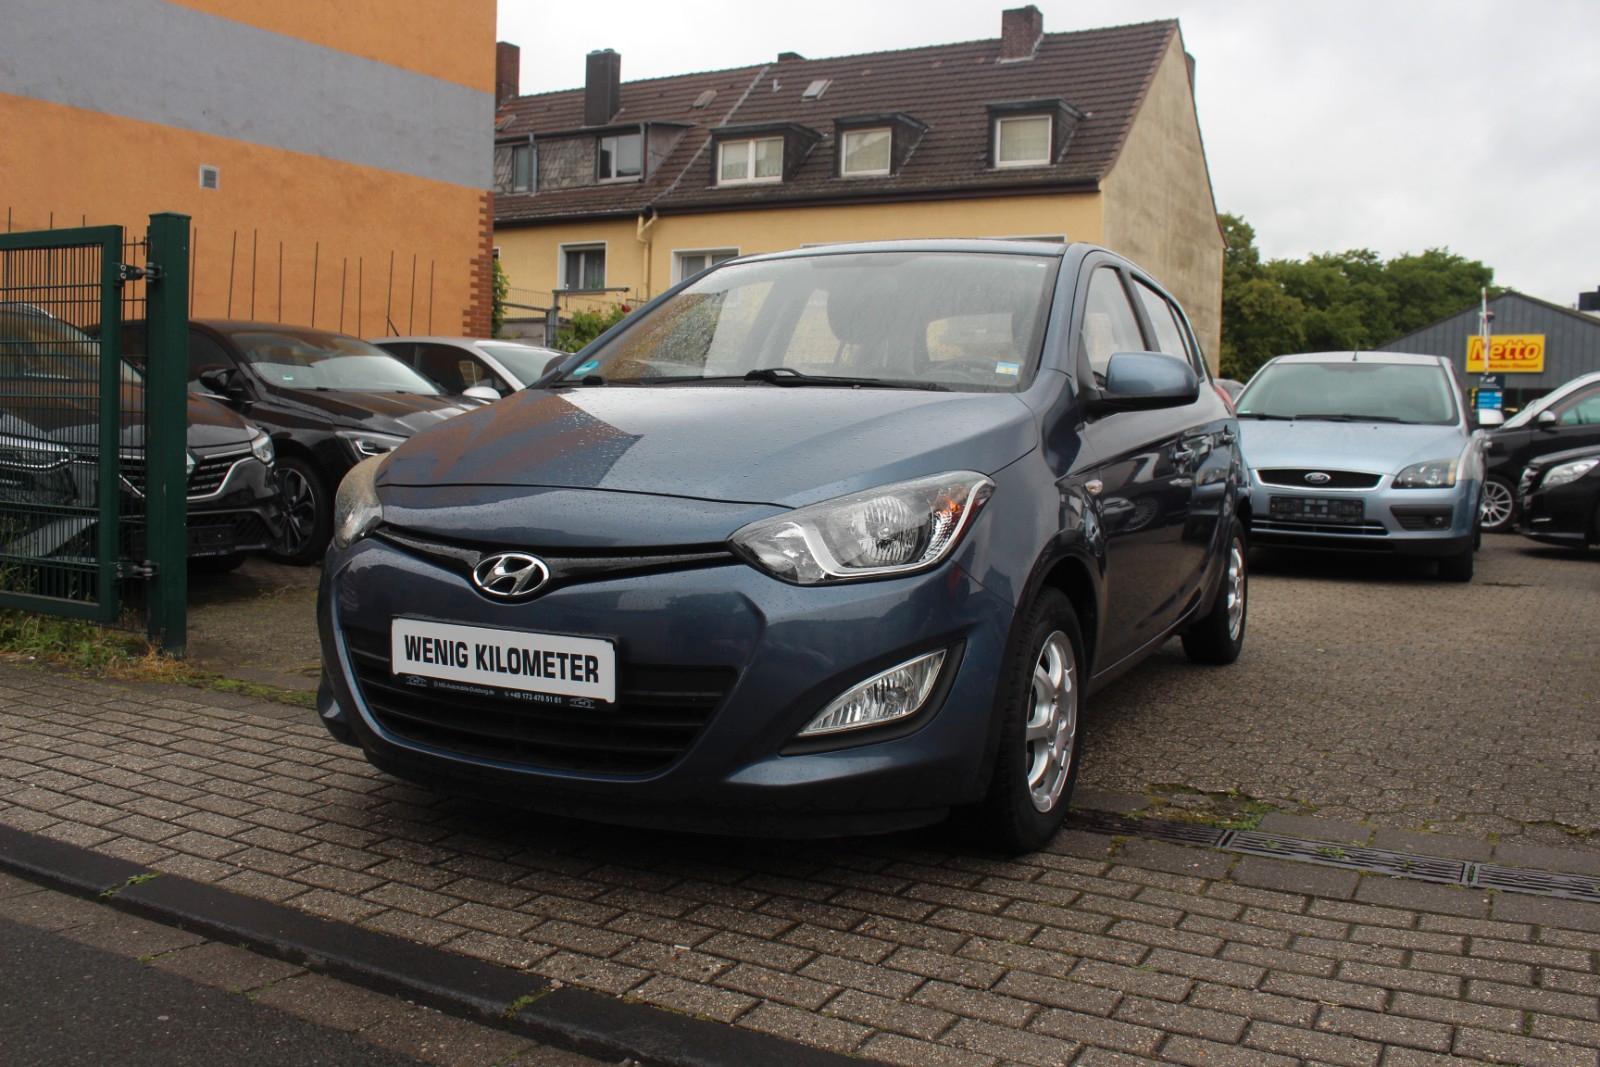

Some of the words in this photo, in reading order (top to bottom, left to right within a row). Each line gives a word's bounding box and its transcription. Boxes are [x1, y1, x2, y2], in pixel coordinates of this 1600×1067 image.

[1470, 339, 1541, 361] Netto
[404, 634, 469, 668] WENIG
[475, 643, 600, 683] KILOMETER
